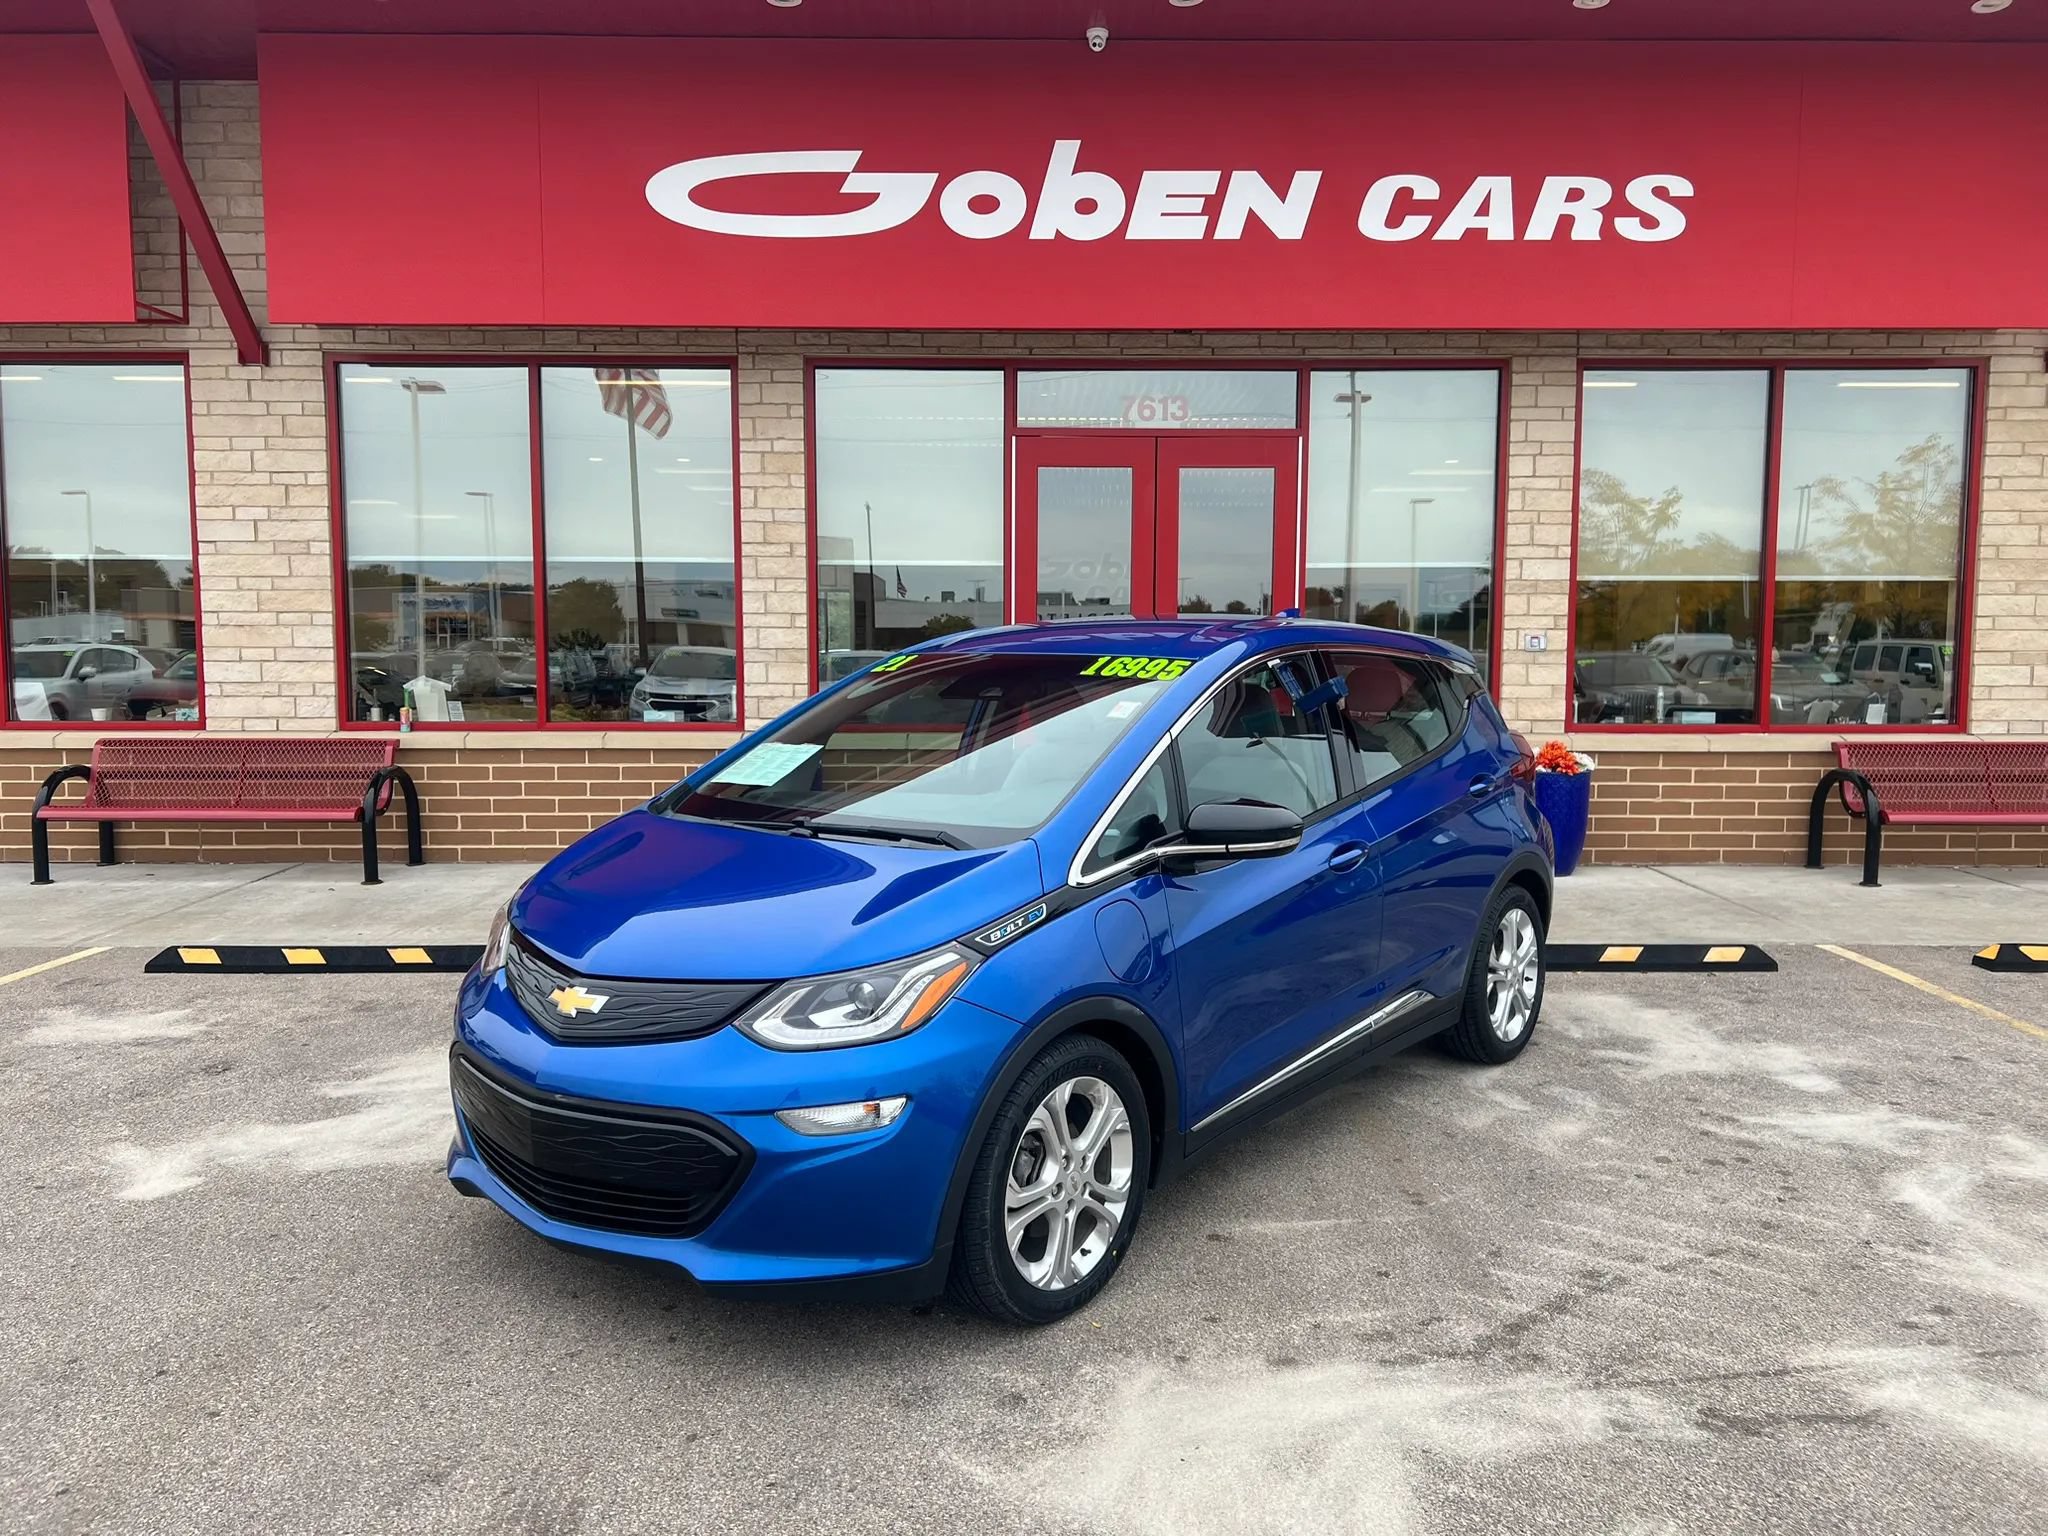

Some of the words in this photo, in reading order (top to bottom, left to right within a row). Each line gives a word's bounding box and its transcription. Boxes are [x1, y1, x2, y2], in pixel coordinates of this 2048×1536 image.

[1358, 174, 1695, 242] CARS
[1119, 395, 1189, 422] 7613
[870, 654, 919, 673] 21
[1080, 656, 1192, 681] 16995
[990, 917, 1025, 942] BOLT
[1028, 907, 1044, 921] EV
